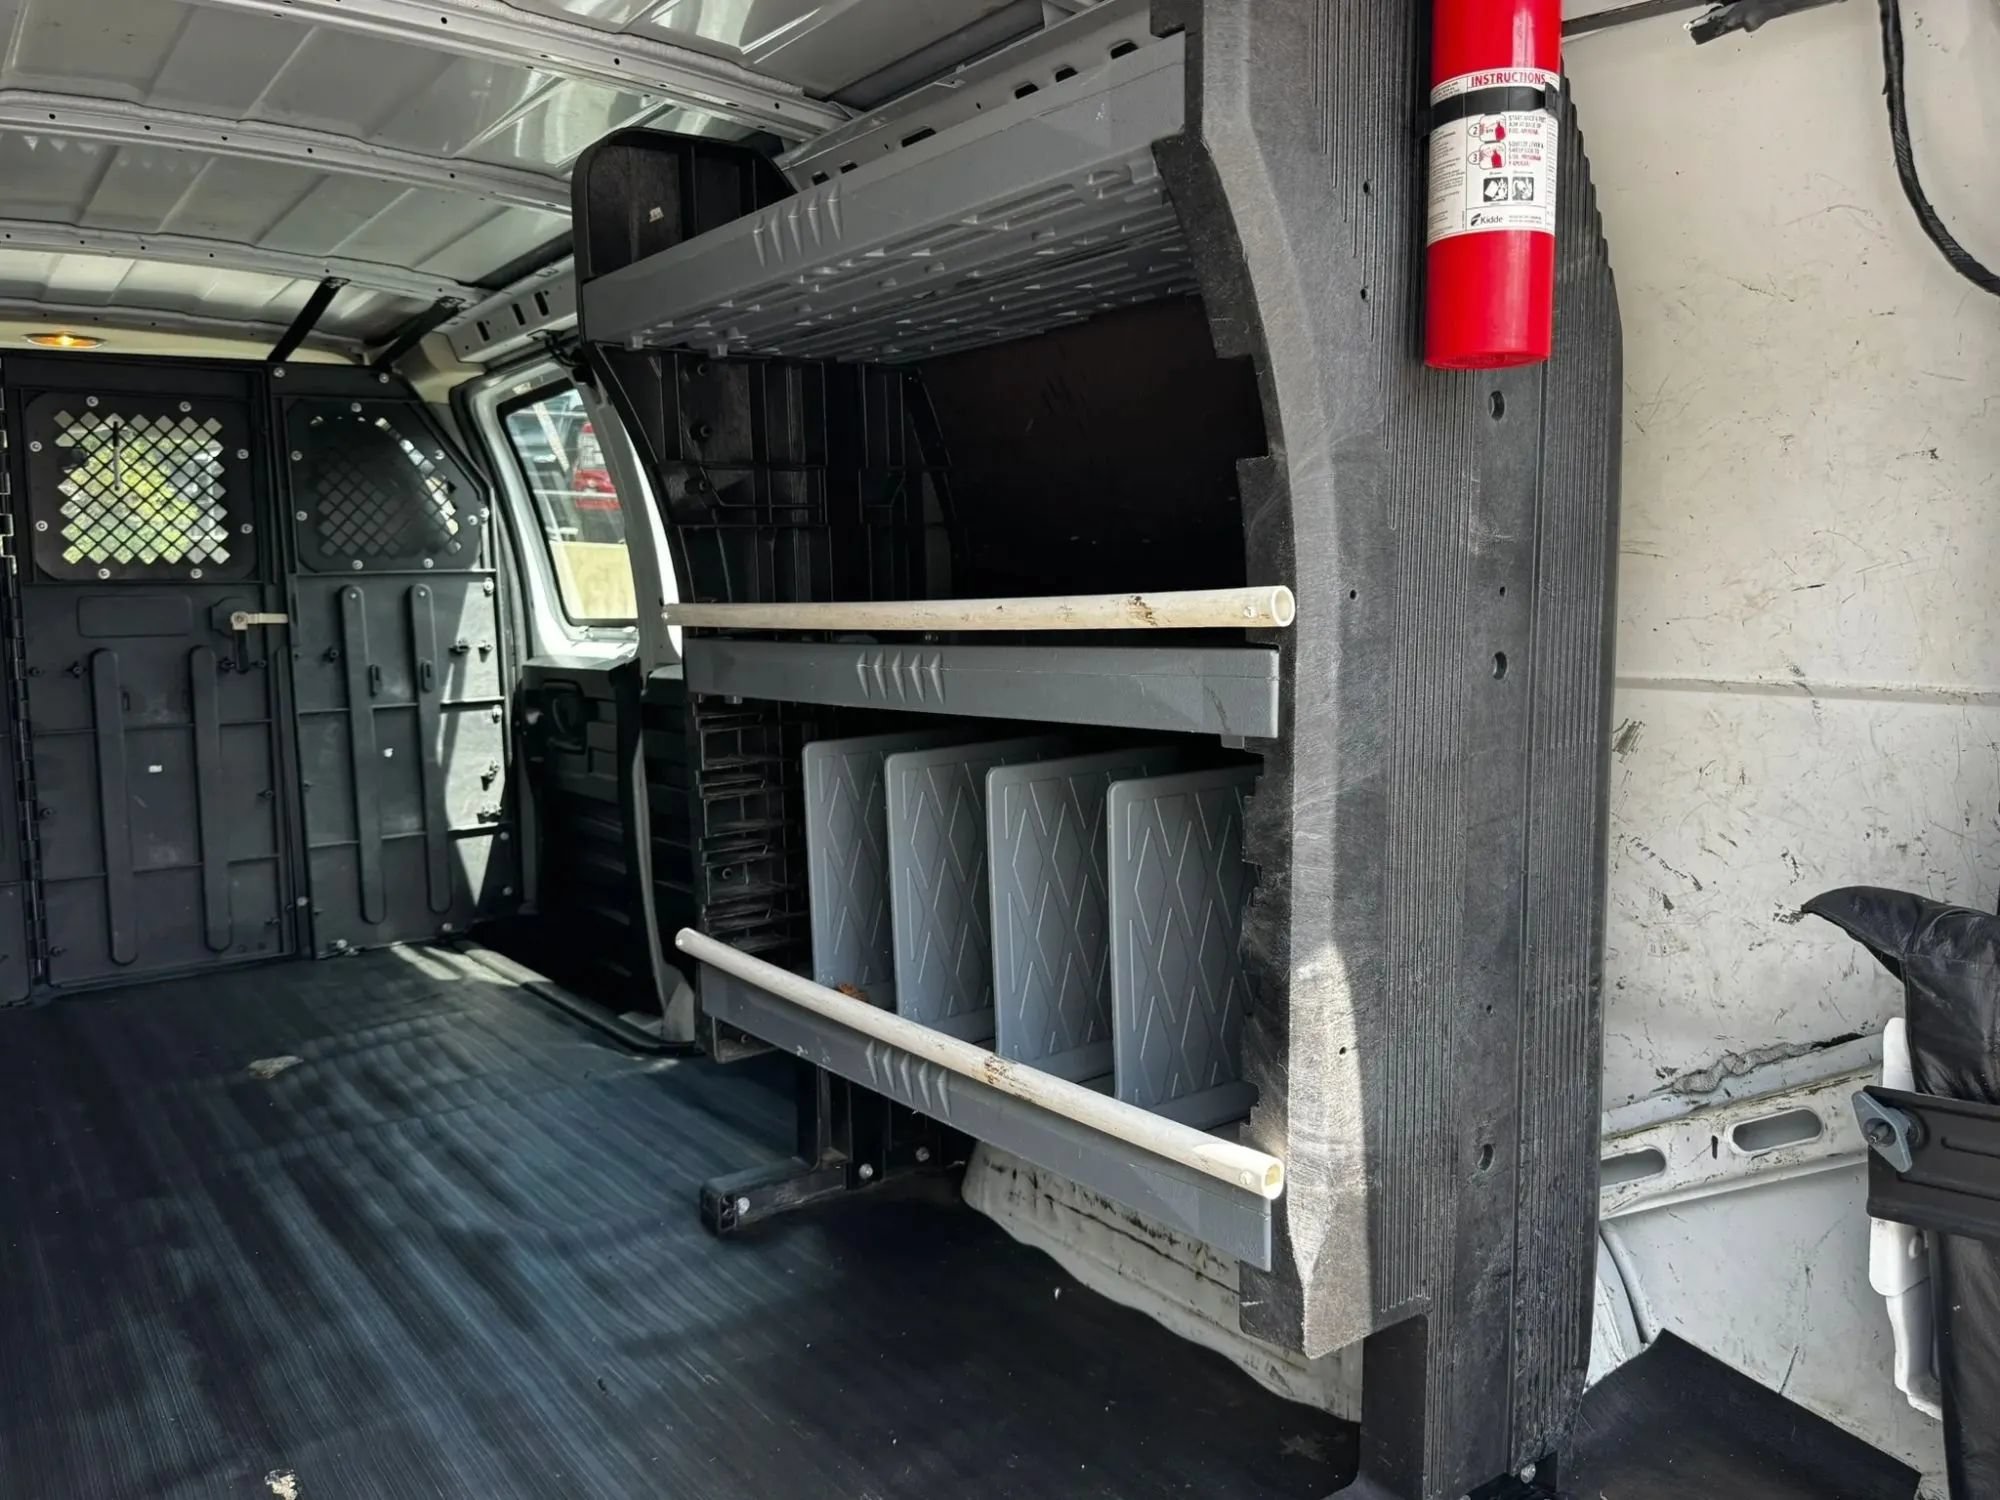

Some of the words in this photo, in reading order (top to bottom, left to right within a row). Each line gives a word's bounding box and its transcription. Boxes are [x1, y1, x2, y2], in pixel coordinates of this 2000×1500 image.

[1471, 71, 1546, 87] INSTRUCTIONS
[1473, 126, 1478, 135] 2
[1473, 153, 1478, 163] 3
[1480, 215, 1504, 225] Kidde
